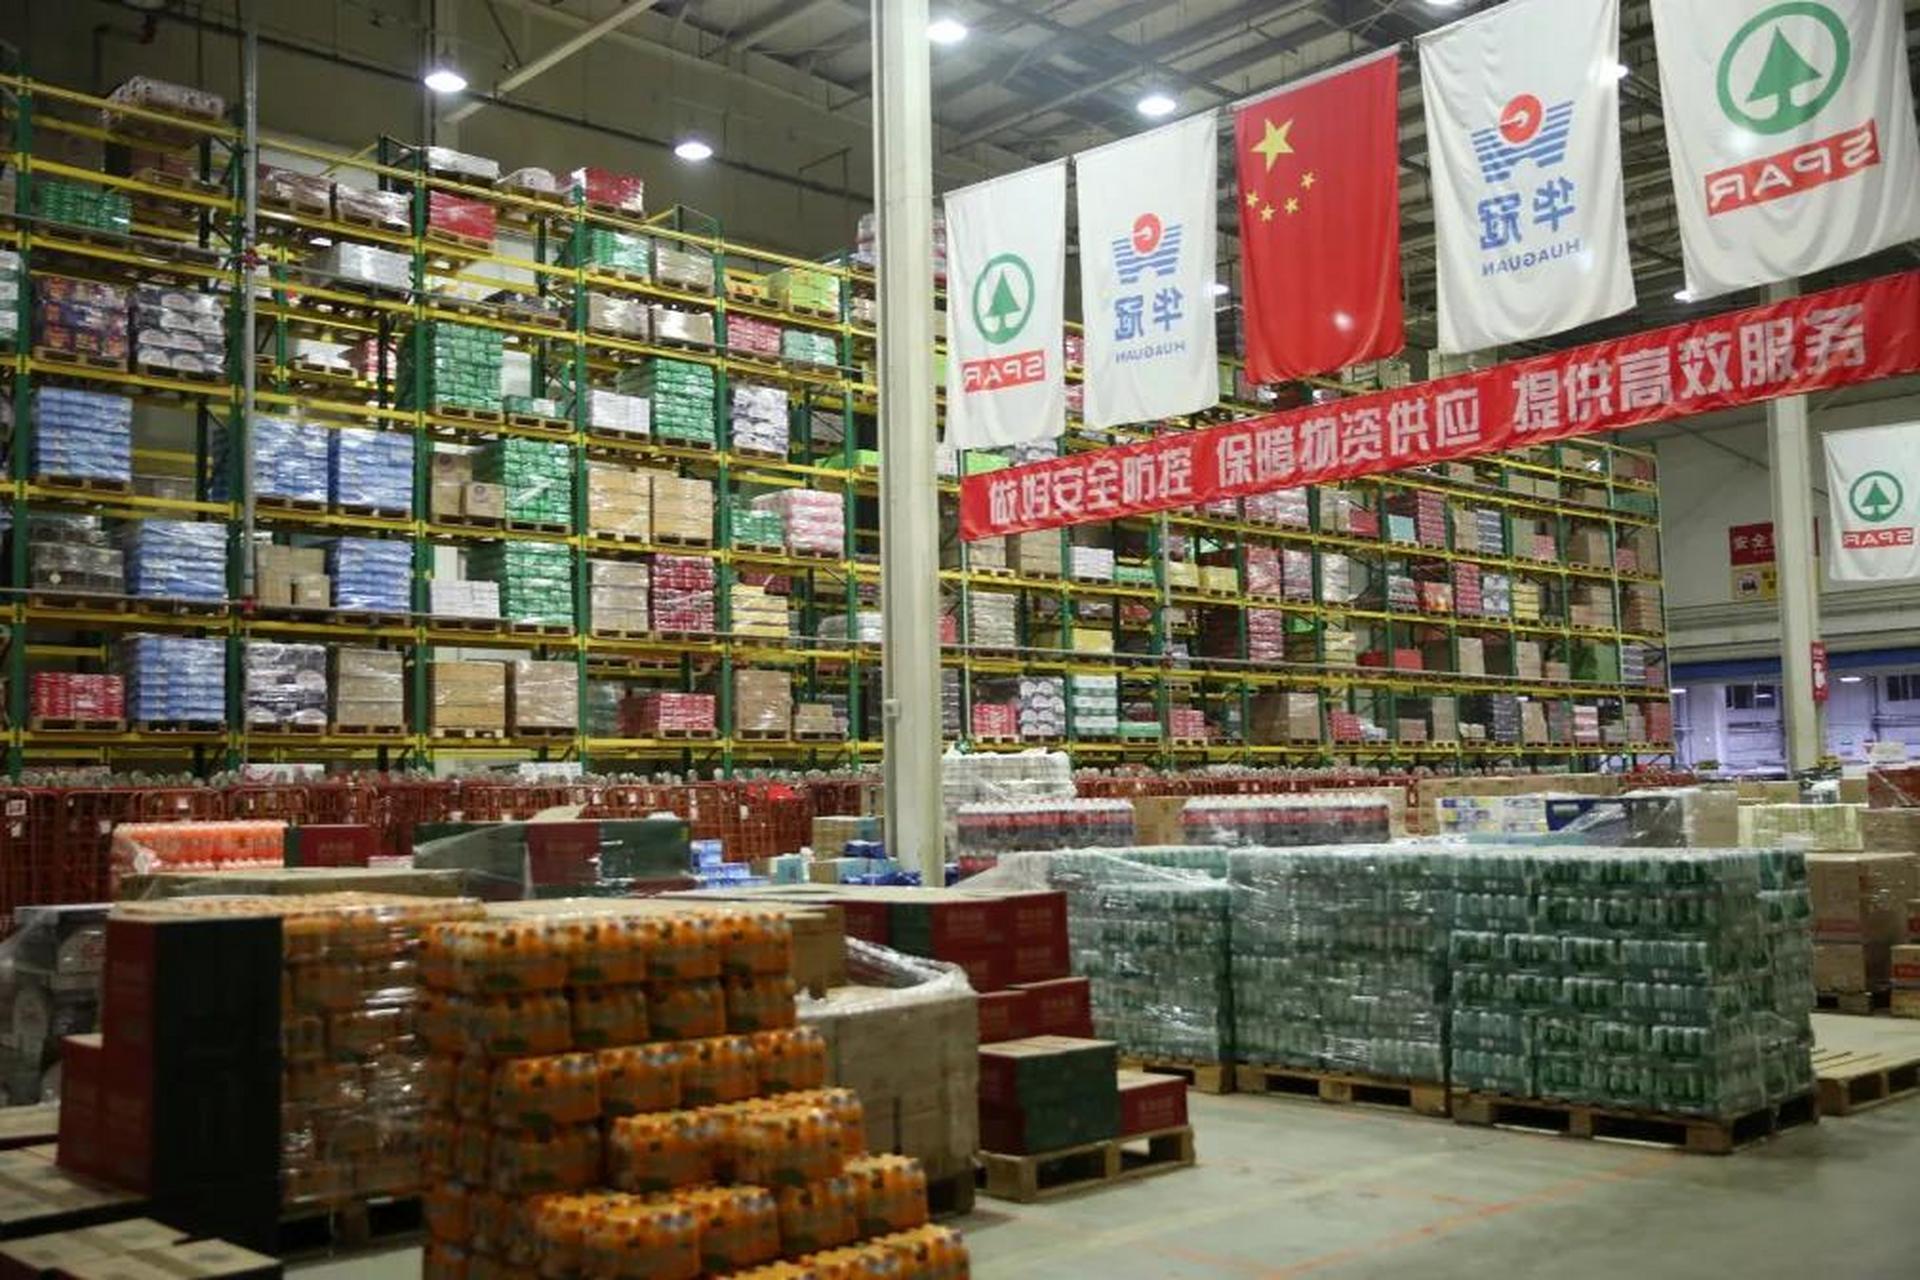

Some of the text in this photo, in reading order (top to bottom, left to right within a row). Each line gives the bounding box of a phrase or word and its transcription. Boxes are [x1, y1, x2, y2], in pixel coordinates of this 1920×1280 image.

[988, 303, 1866, 526] 做好安全防控 保障物资供应 提供高效服务
